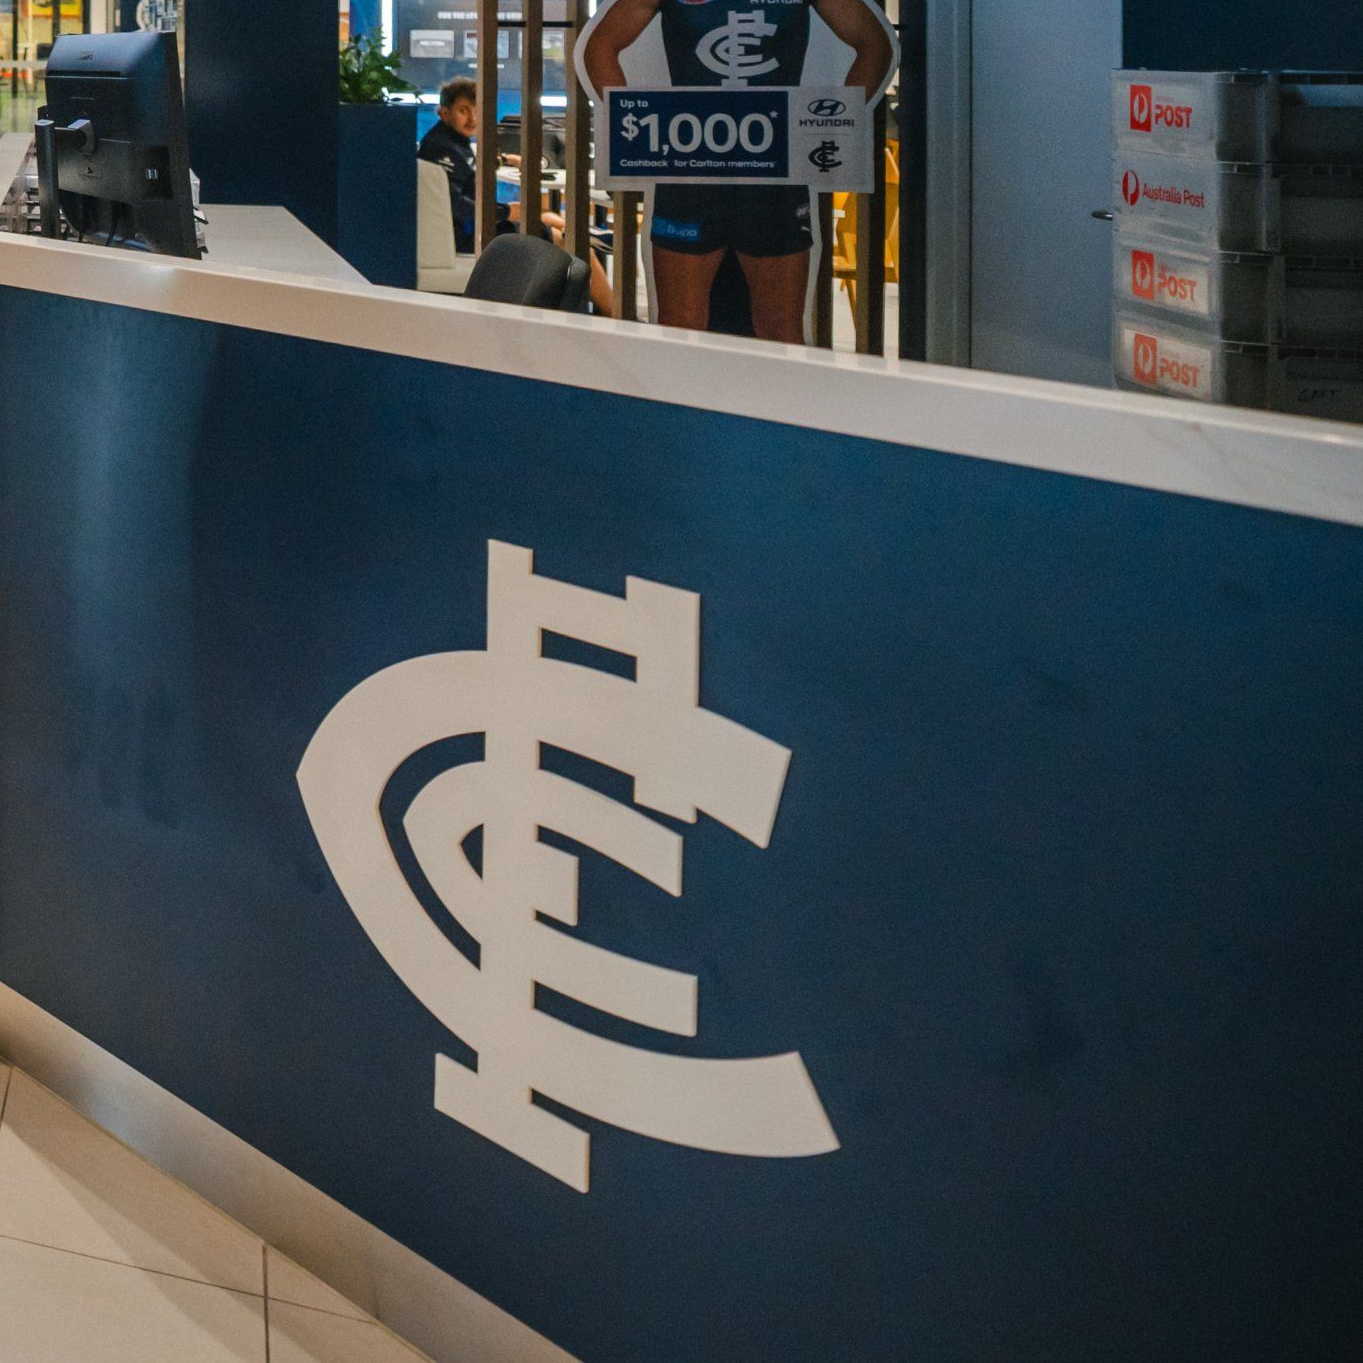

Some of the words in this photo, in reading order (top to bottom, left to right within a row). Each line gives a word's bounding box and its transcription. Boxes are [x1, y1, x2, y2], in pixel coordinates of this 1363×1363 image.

[620, 99, 634, 108] Up
[637, 100, 648, 108] to
[799, 119, 854, 127] HYUNDAI
[1156, 104, 1192, 128] POST
[620, 159, 668, 167] Cashback
[674, 159, 687, 167] for
[690, 159, 725, 167] Carlton
[1143, 183, 1181, 204] Australia
[1184, 190, 1204, 208] Post
[667, 225, 697, 237] Bupa
[1158, 272, 1197, 302] POST
[1160, 357, 1200, 387] POST
